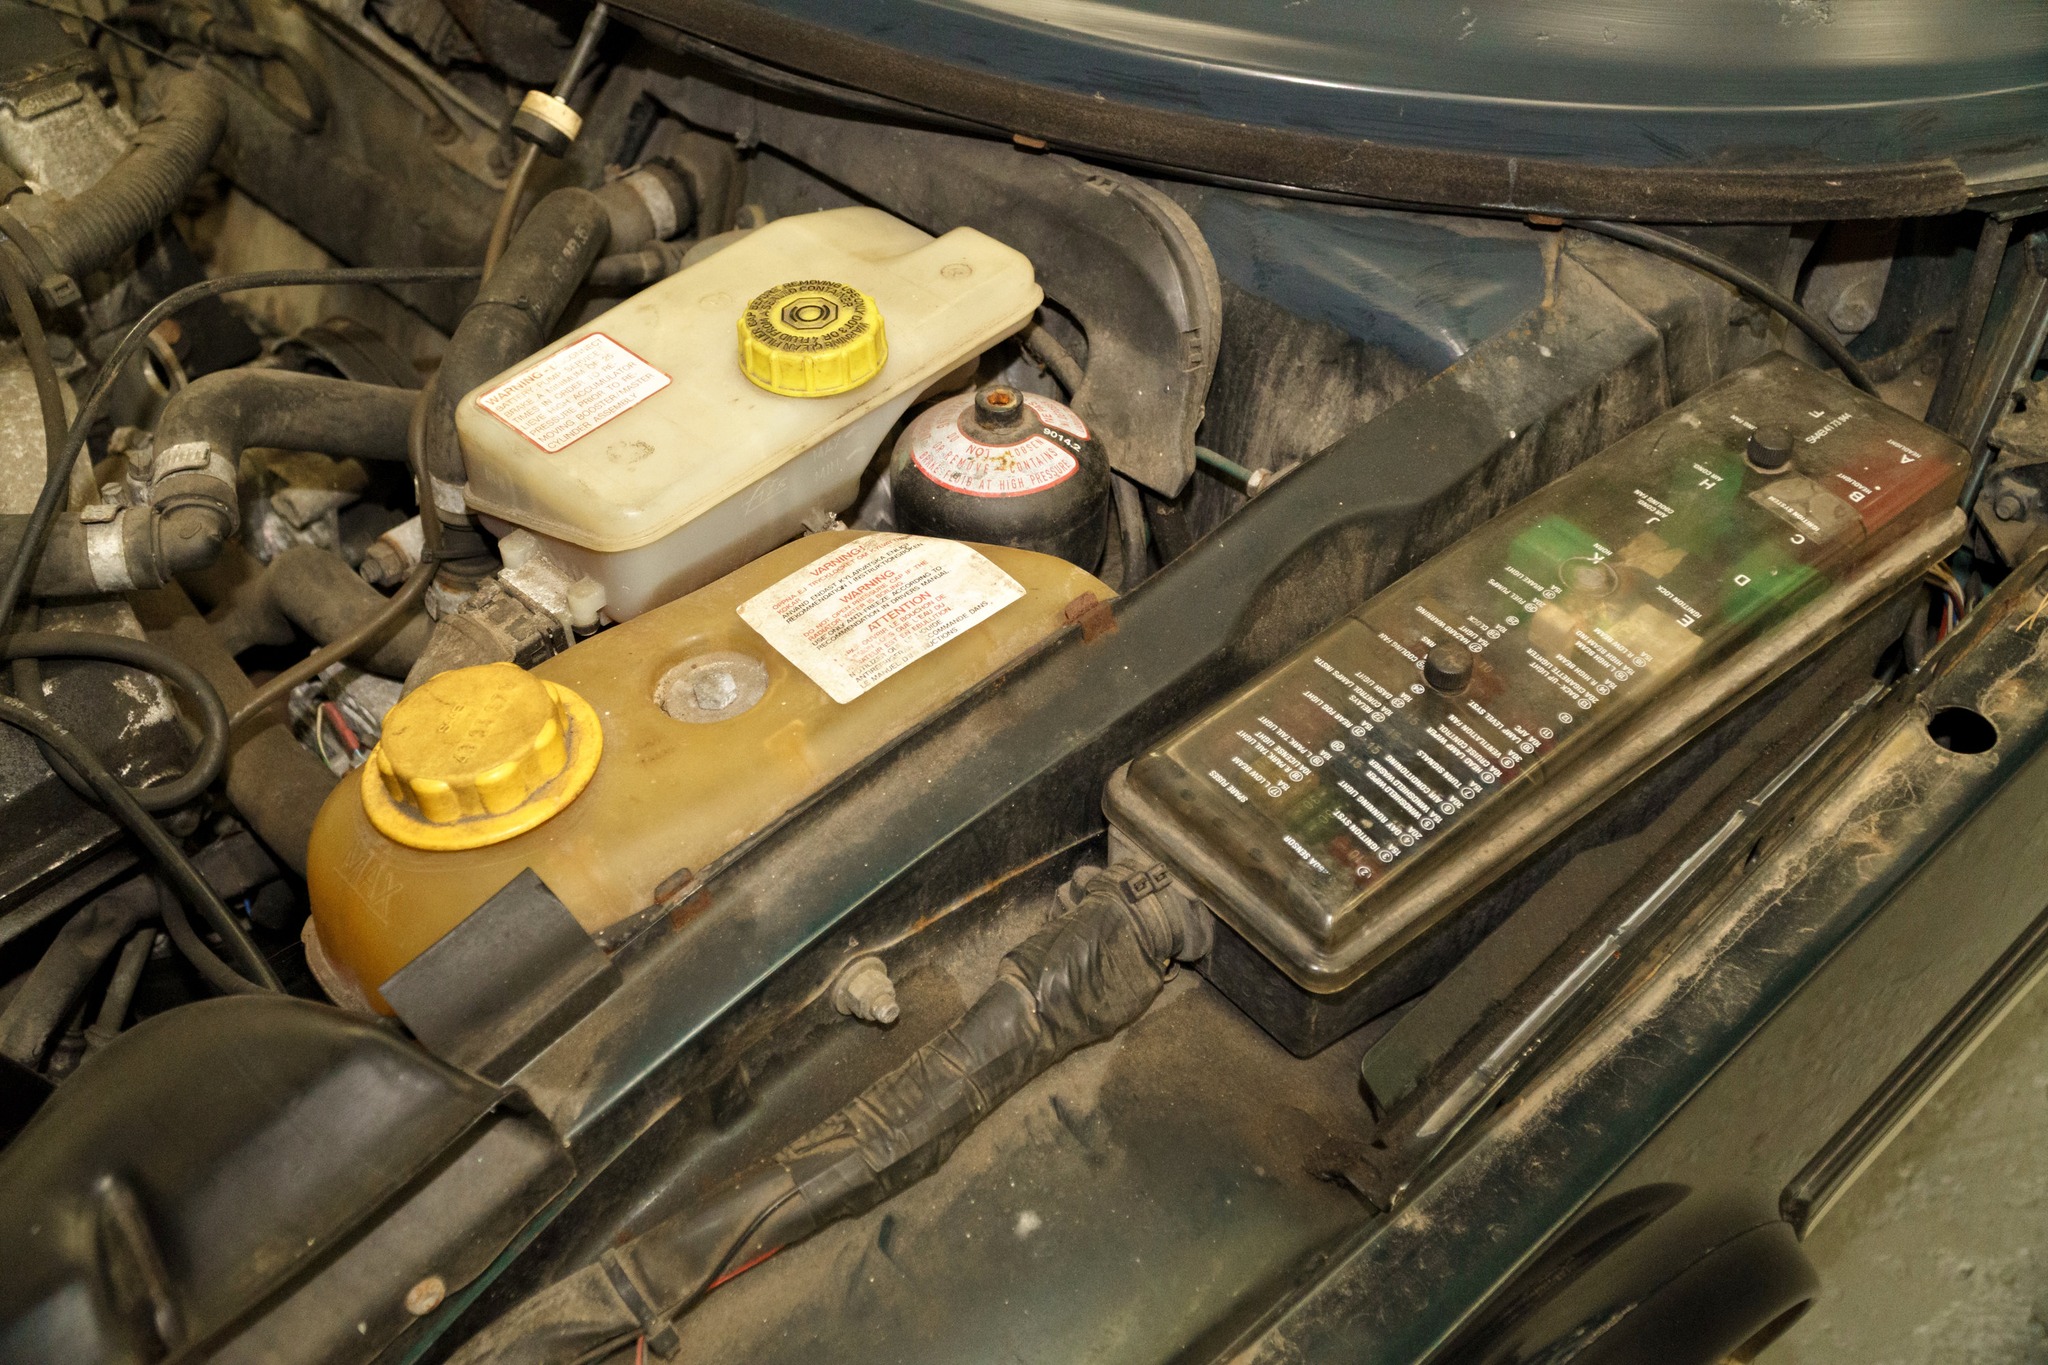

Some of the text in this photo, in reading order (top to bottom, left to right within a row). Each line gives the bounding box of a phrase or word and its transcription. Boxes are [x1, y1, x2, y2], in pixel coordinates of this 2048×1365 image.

[751, 327, 780, 347] FILLER
[759, 317, 778, 337] FROM
[779, 332, 810, 344] FLUID
[823, 331, 840, 341] OR
[486, 371, 542, 404] WARNING
[520, 361, 636, 429] LIEVE HIGH ACCUMULATOR
[503, 398, 533, 416] BRAKE
[512, 406, 539, 422] TIMES
[529, 381, 620, 434] PRESSURE PRIOR TO
[1809, 407, 1824, 417] F
[538, 419, 574, 441] MOVING
[546, 393, 639, 448] CYLINDER ASSEMBLY
[944, 451, 989, 474] REMOVE
[1009, 448, 1058, 474] CONTAINS
[1887, 437, 1921, 459] HEADLIGHT
[1897, 454, 1913, 465] A
[919, 451, 942, 474] BRAKE
[978, 479, 992, 491] AT
[1000, 478, 1025, 491] HIGH
[1030, 458, 1071, 485] PRESSURE
[1699, 478, 1715, 489] H
[1710, 473, 1723, 481] AIR
[1837, 471, 1871, 495] HEADLIGHT
[1633, 488, 1674, 514] COOLING FAN
[1848, 490, 1865, 501] B
[1646, 516, 1659, 525] J
[1655, 509, 1667, 518] AIR
[1768, 495, 1820, 531] IGNITION SYSTEM
[1593, 542, 1612, 555] HORN
[1789, 533, 1806, 544] C
[1587, 552, 1604, 563] K
[808, 559, 856, 586] TRYCKLOCKET
[839, 569, 895, 602] WARNING
[1505, 565, 1543, 591] BRAKE LIGHT
[1733, 573, 1750, 585] D
[783, 584, 849, 622] REKOMMENDATION
[802, 628, 815, 636] DO
[814, 618, 830, 628] NOT
[830, 605, 851, 617] OPEN
[850, 583, 888, 605] PRESSURE
[888, 573, 904, 583] CAP
[913, 560, 928, 568] THE
[809, 582, 838, 599] ENDAST
[1488, 578, 1525, 604] FUEL PUMPS
[1656, 585, 1702, 618] IGNITION LOCK
[776, 598, 802, 613] KOKAR
[811, 635, 827, 645] USE
[826, 623, 846, 635] ONLY
[890, 572, 931, 595] ACCORDING
[814, 609, 882, 649] RECOMMENDATION
[890, 586, 920, 603] DRIVERS
[865, 591, 931, 631] ATTENTION
[1415, 605, 1446, 627] WARNING
[806, 618, 842, 640] RADIATOR
[841, 603, 866, 618] WATER
[861, 628, 888, 644] OUVRIR
[899, 600, 934, 621] BOUCHON
[895, 621, 911, 632] QUE
[1458, 624, 1478, 638] LIGHT
[1467, 615, 1488, 630] CLOCK
[1677, 614, 1694, 626] E
[884, 630, 911, 647] EST EN
[1378, 632, 1418, 661] COOLING FAN
[1444, 625, 1469, 644] HAZARD
[1575, 640, 1595, 655] BEAM
[1593, 627, 1613, 642] BEAM
[1555, 653, 1575, 668] BEAM
[1586, 638, 1623, 665] HIGH BEAM
[1526, 648, 1586, 692] CIGARETTE LIGHTER
[1529, 661, 1549, 676] LIGHT
[1332, 670, 1381, 707] CONTROL LAMPS
[1355, 670, 1392, 699] DASH LIGHT
[1303, 690, 1352, 727] REAR FOG LIGHT
[1348, 694, 1373, 713] RELAYS
[1466, 699, 1521, 742] LAMP LEVEL SYST.
[1514, 725, 1529, 736] APC
[1255, 730, 1301, 766] LICENSE LIGHT
[1437, 724, 1491, 766] CRUISE CONTROL
[1447, 714, 1503, 757] VENTILATION FAN
[1426, 727, 1483, 772] HEAD LAMP WIPER
[1231, 756, 1251, 772] BEAM
[1416, 749, 1463, 787] TURN SIGNALS
[1208, 770, 1248, 802] SPARE FUSES
[1368, 759, 1432, 812] WINDSHIELD WASHER
[1383, 754, 1443, 802] AIR CONDITIONING
[1337, 779, 1402, 835] DAY RUNNING LIGHT
[1365, 770, 1423, 818] WINDSHIELD WIPER
[1282, 835, 1312, 858] SENSOR
[1348, 824, 1382, 850] IGNITION
